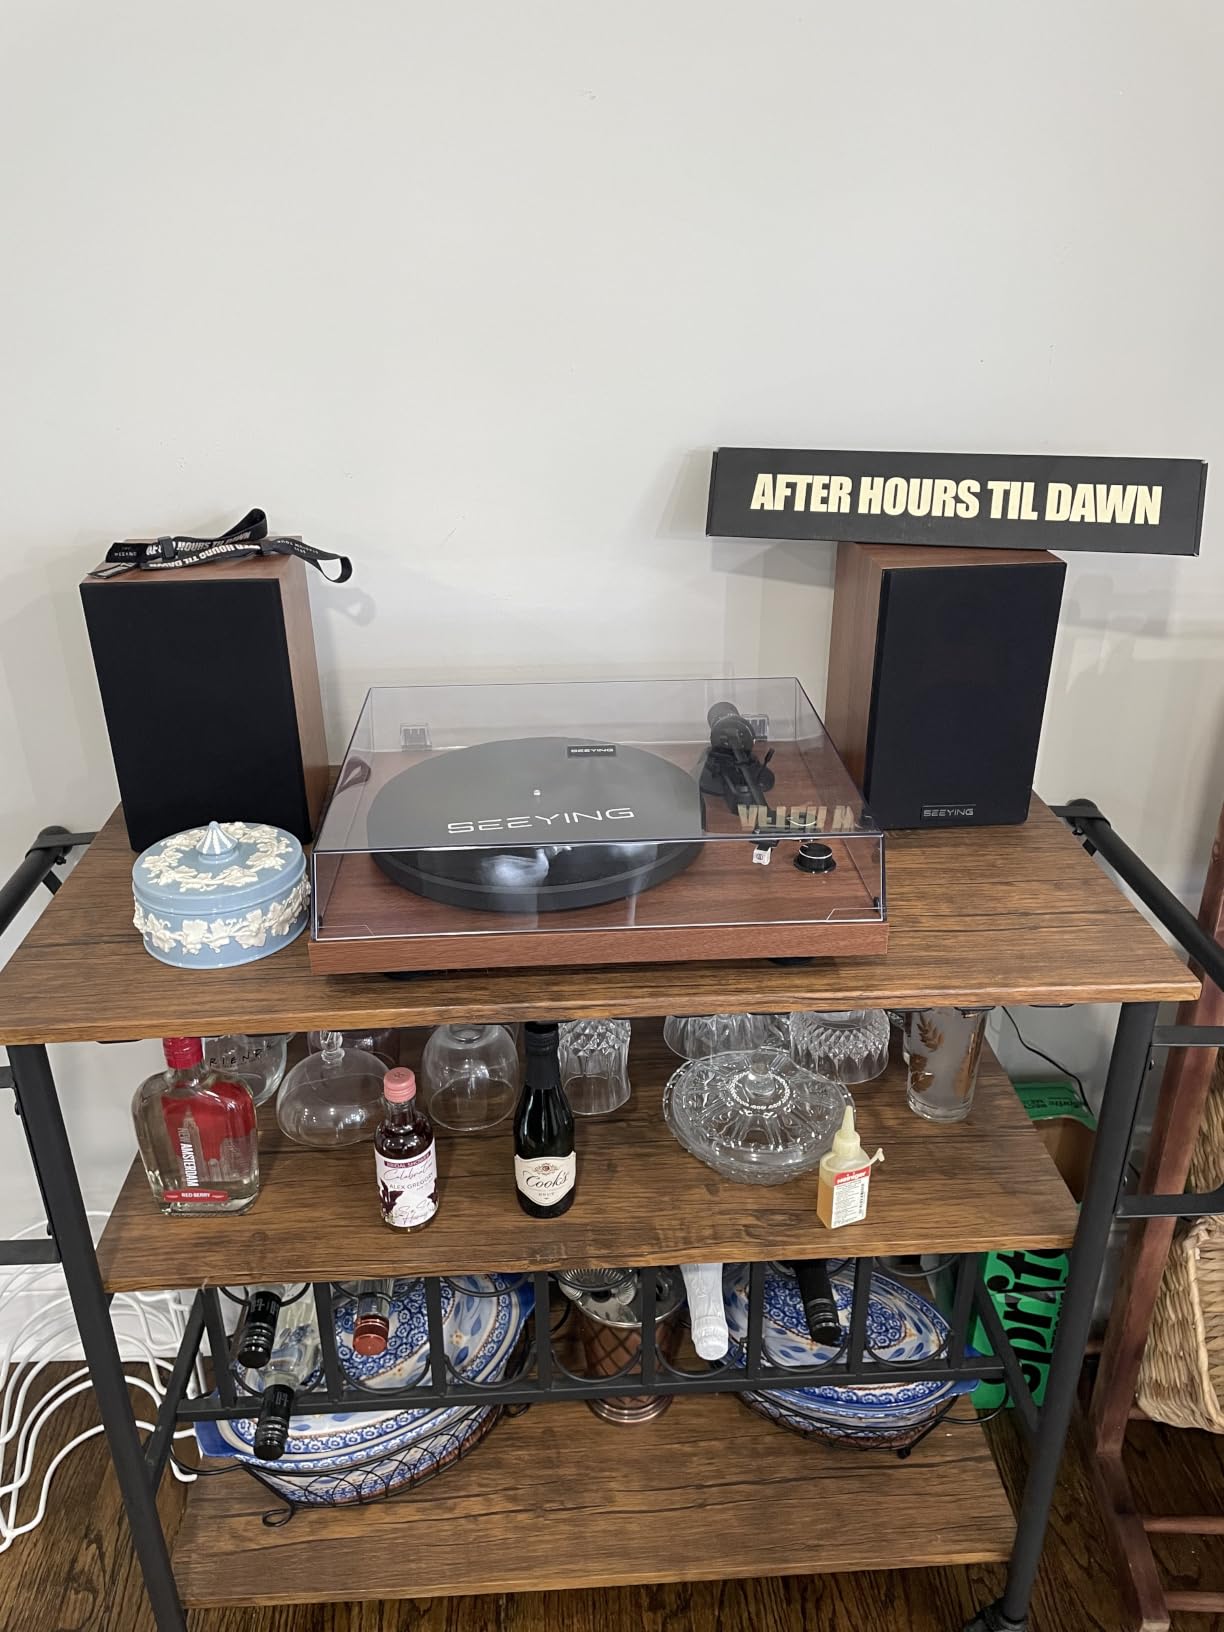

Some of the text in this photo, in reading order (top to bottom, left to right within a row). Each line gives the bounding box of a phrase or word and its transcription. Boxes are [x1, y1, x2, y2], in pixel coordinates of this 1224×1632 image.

[750, 473, 1163, 525] AFTER HOURS TIL DAWN
[176, 541, 211, 551] HOURS
[447, 807, 635, 834] SEEYING
[923, 808, 974, 817] SEEYING
[180, 1143, 199, 1187] AMSTERDAM
[526, 1169, 568, 1188] Cook's
